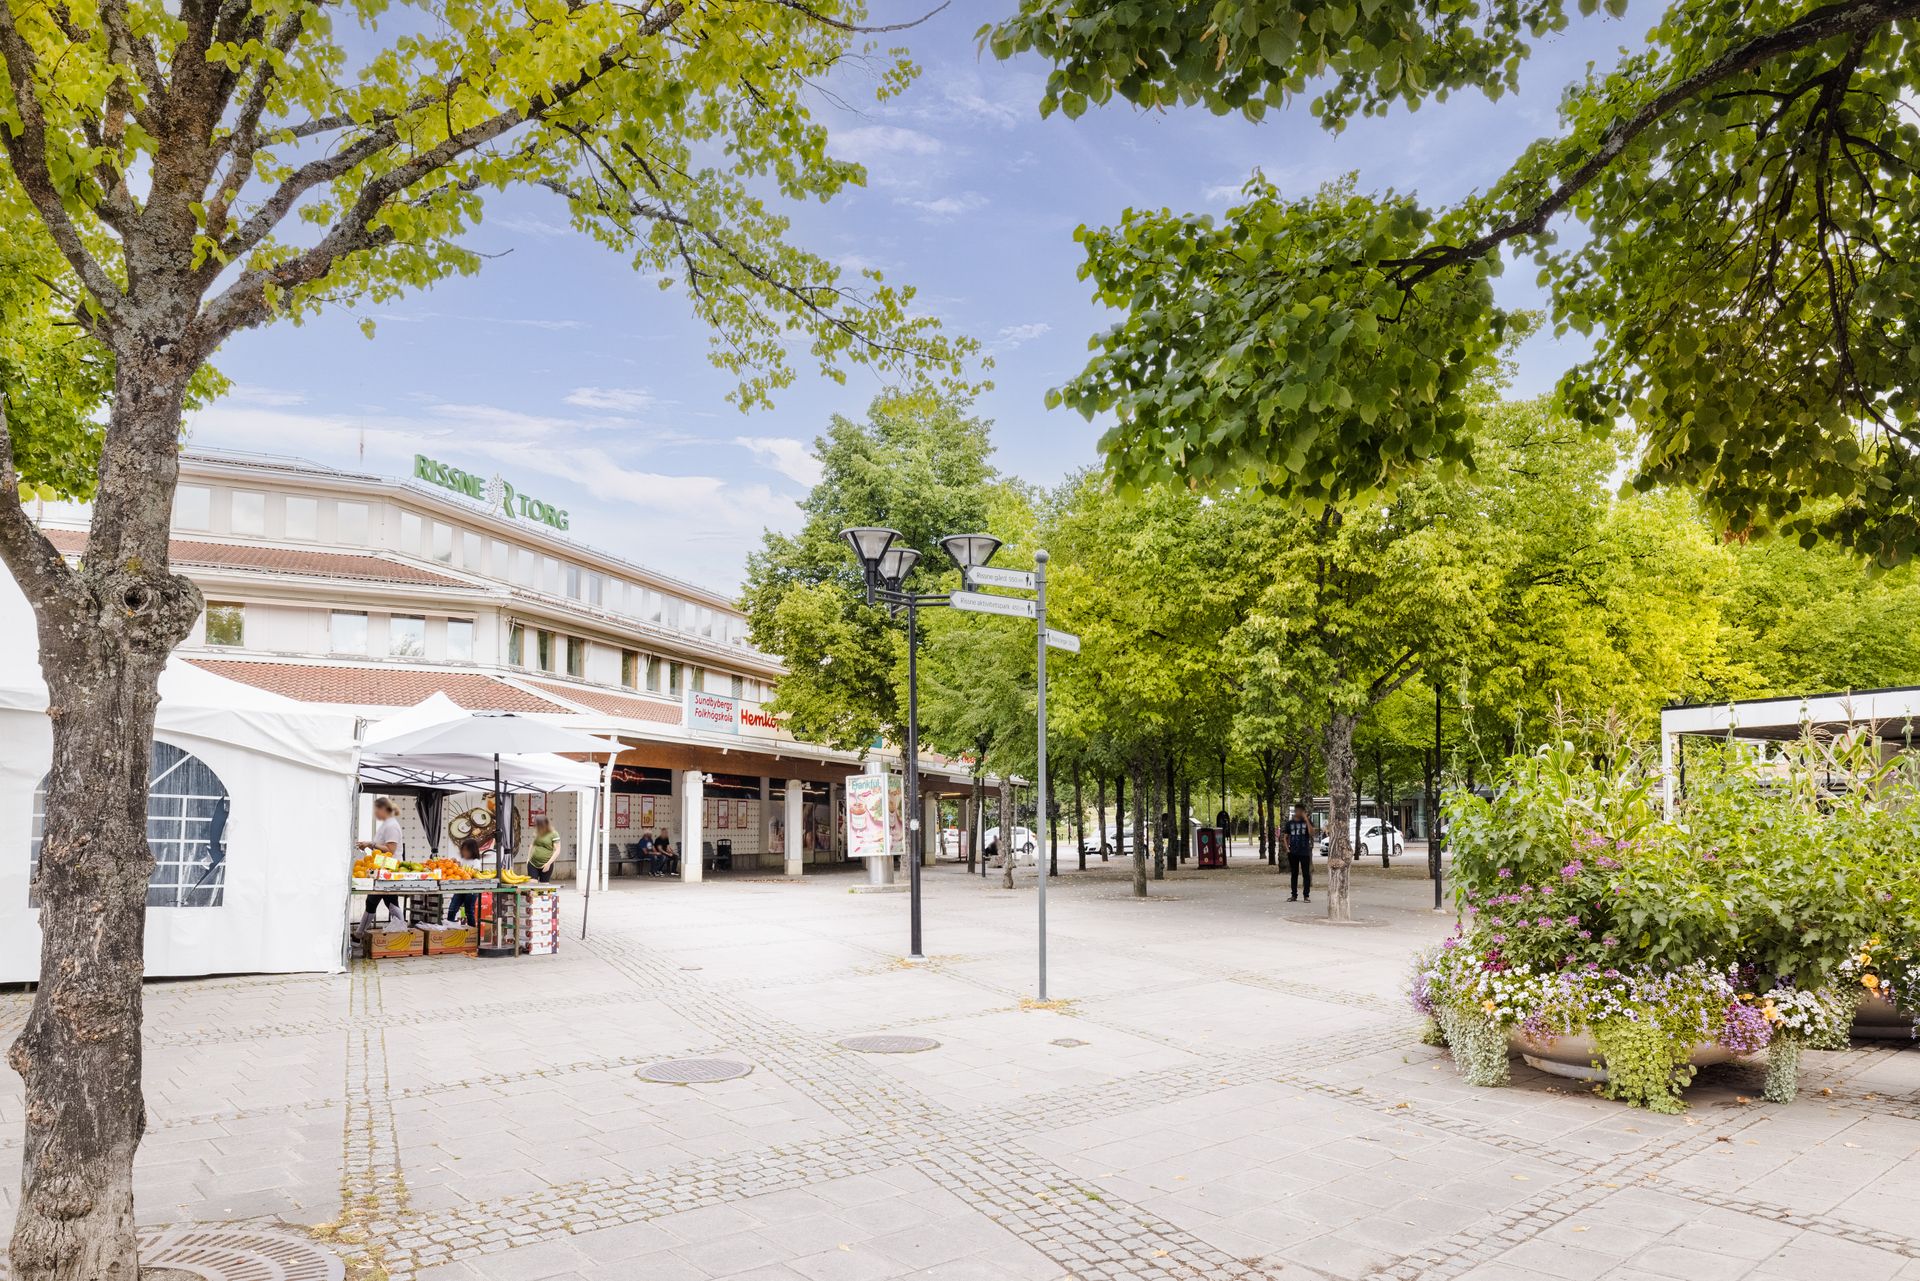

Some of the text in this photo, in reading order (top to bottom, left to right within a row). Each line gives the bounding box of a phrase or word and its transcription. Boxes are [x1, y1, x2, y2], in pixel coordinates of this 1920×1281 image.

[414, 454, 485, 500] RISSNE
[517, 493, 569, 531] TORG
[695, 694, 733, 712] Sundbybergs
[695, 707, 733, 722] Folkhögskola
